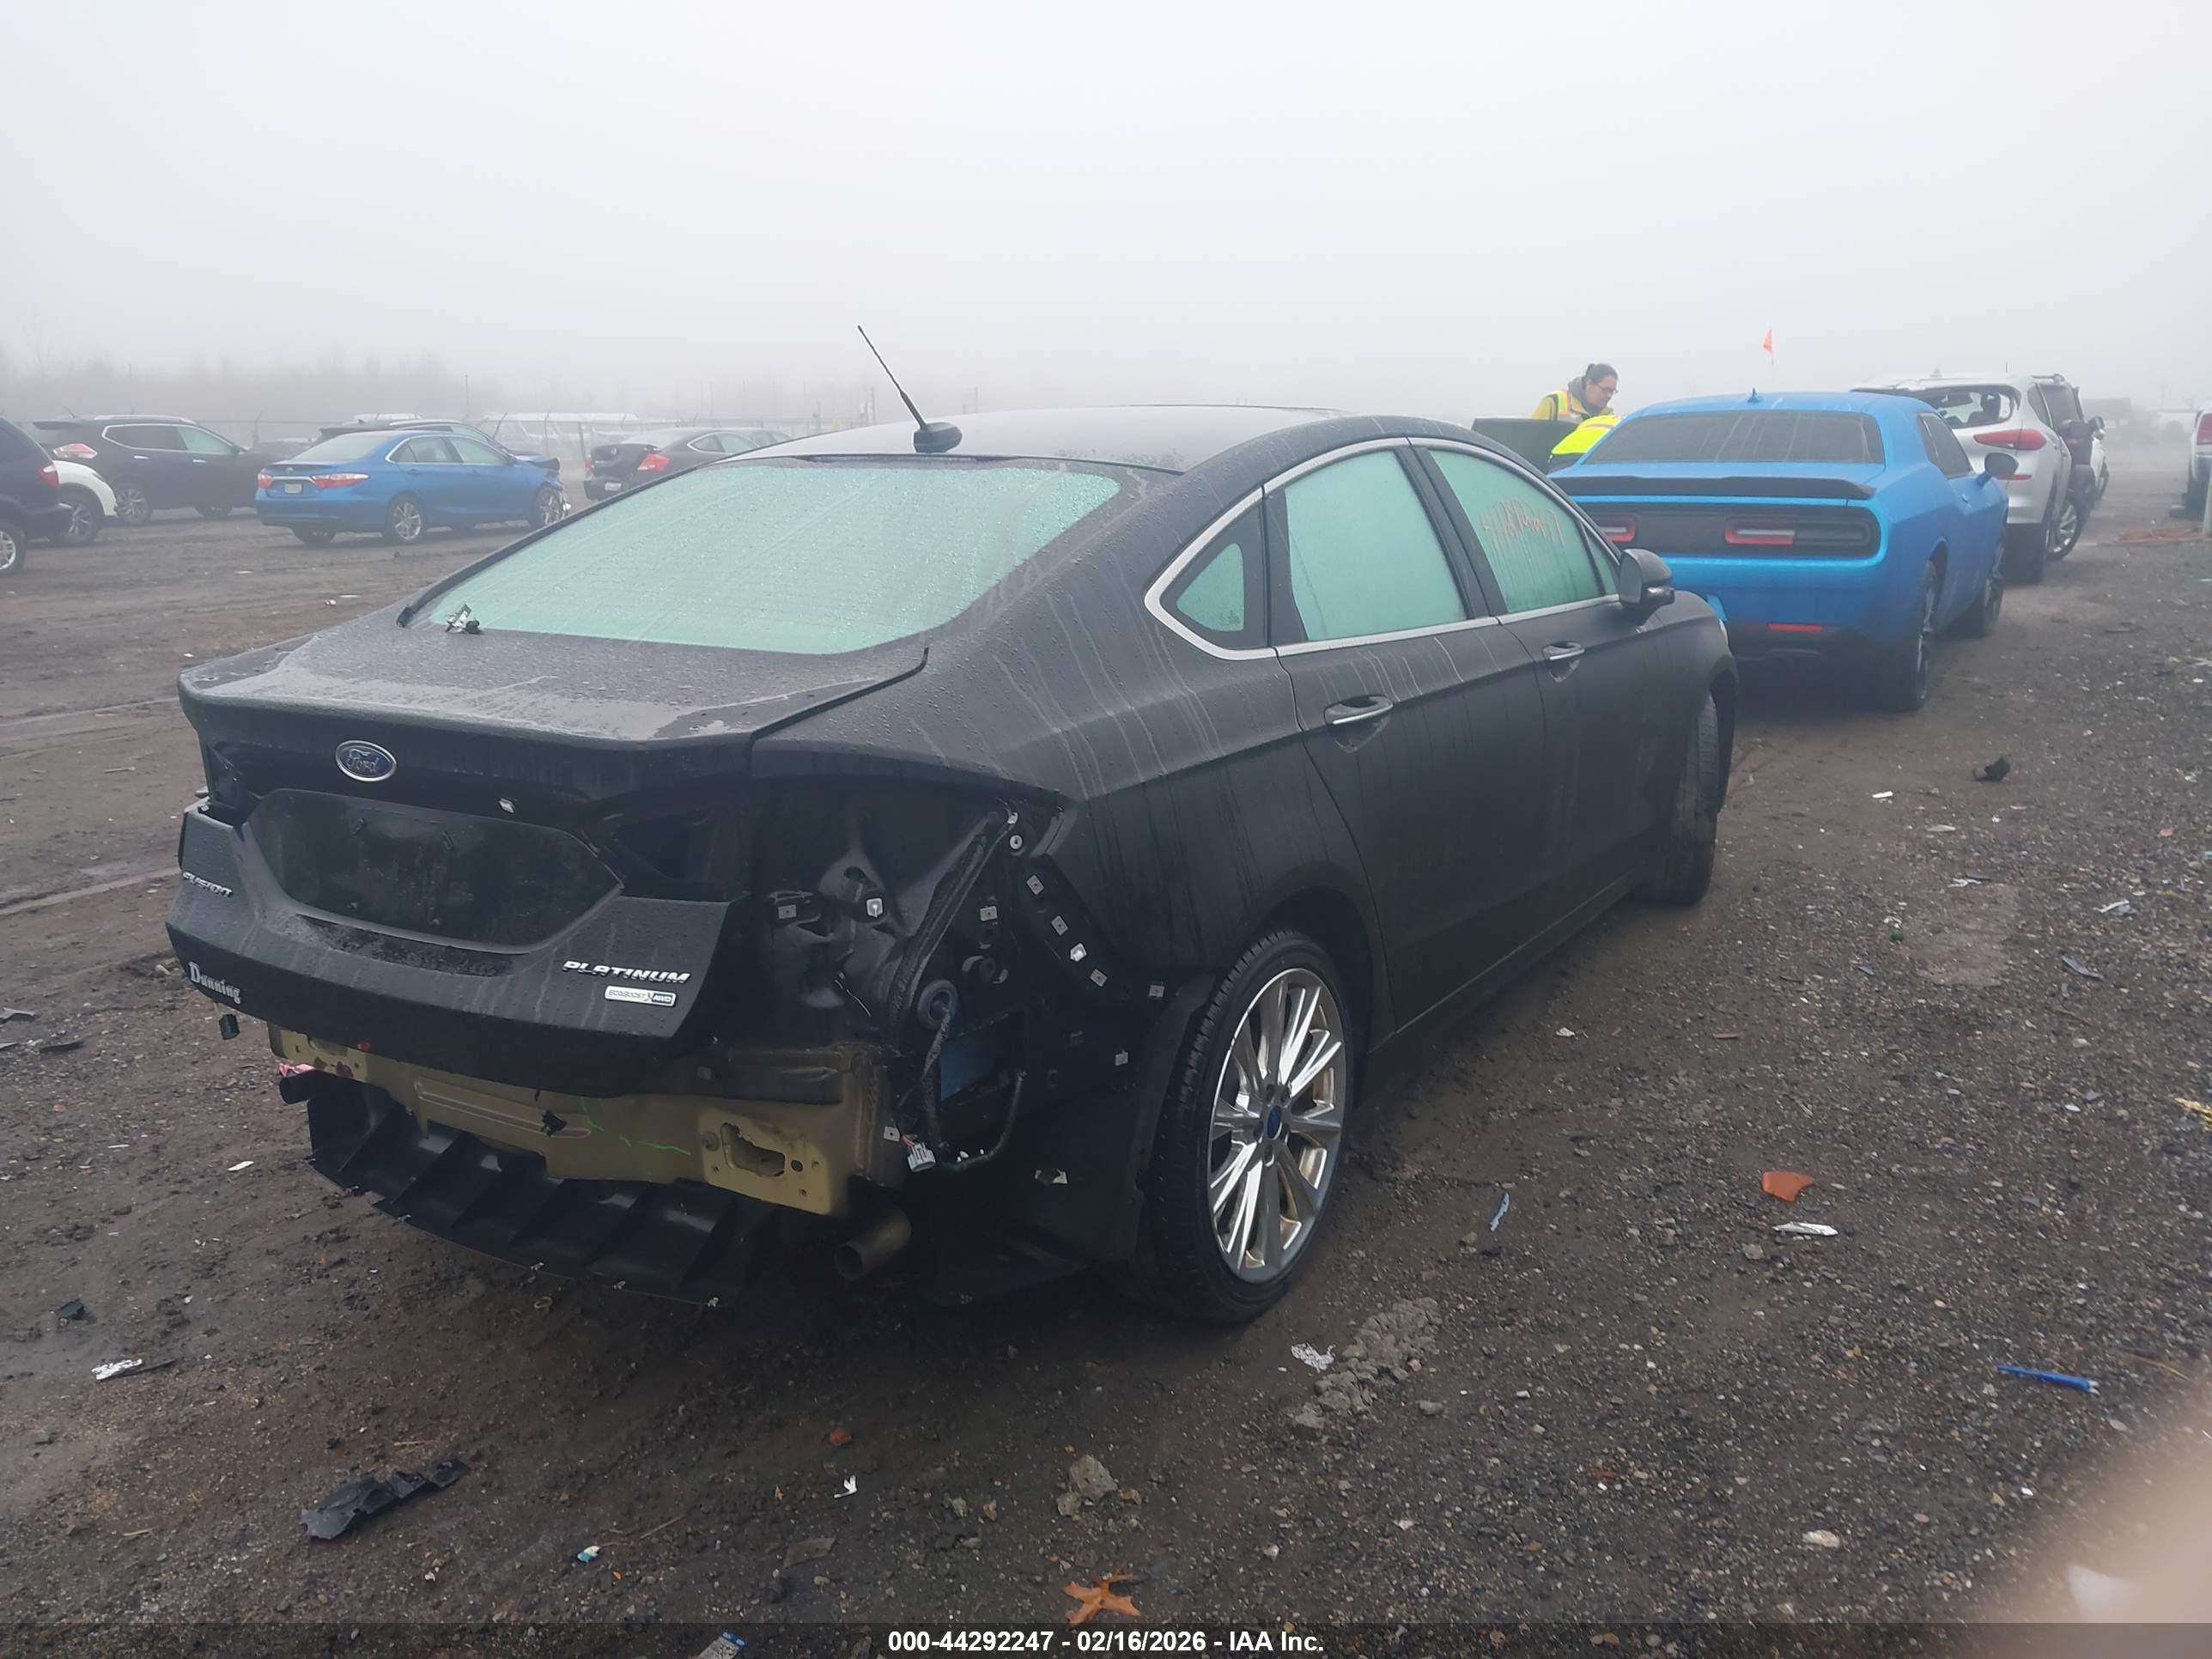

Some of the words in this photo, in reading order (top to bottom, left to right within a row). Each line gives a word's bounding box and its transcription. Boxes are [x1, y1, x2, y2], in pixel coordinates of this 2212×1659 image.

[346, 748, 380, 774] Ford
[188, 961, 241, 1005] Dunning
[562, 960, 690, 983] PLATINUM
[652, 994, 672, 1003] AWD
